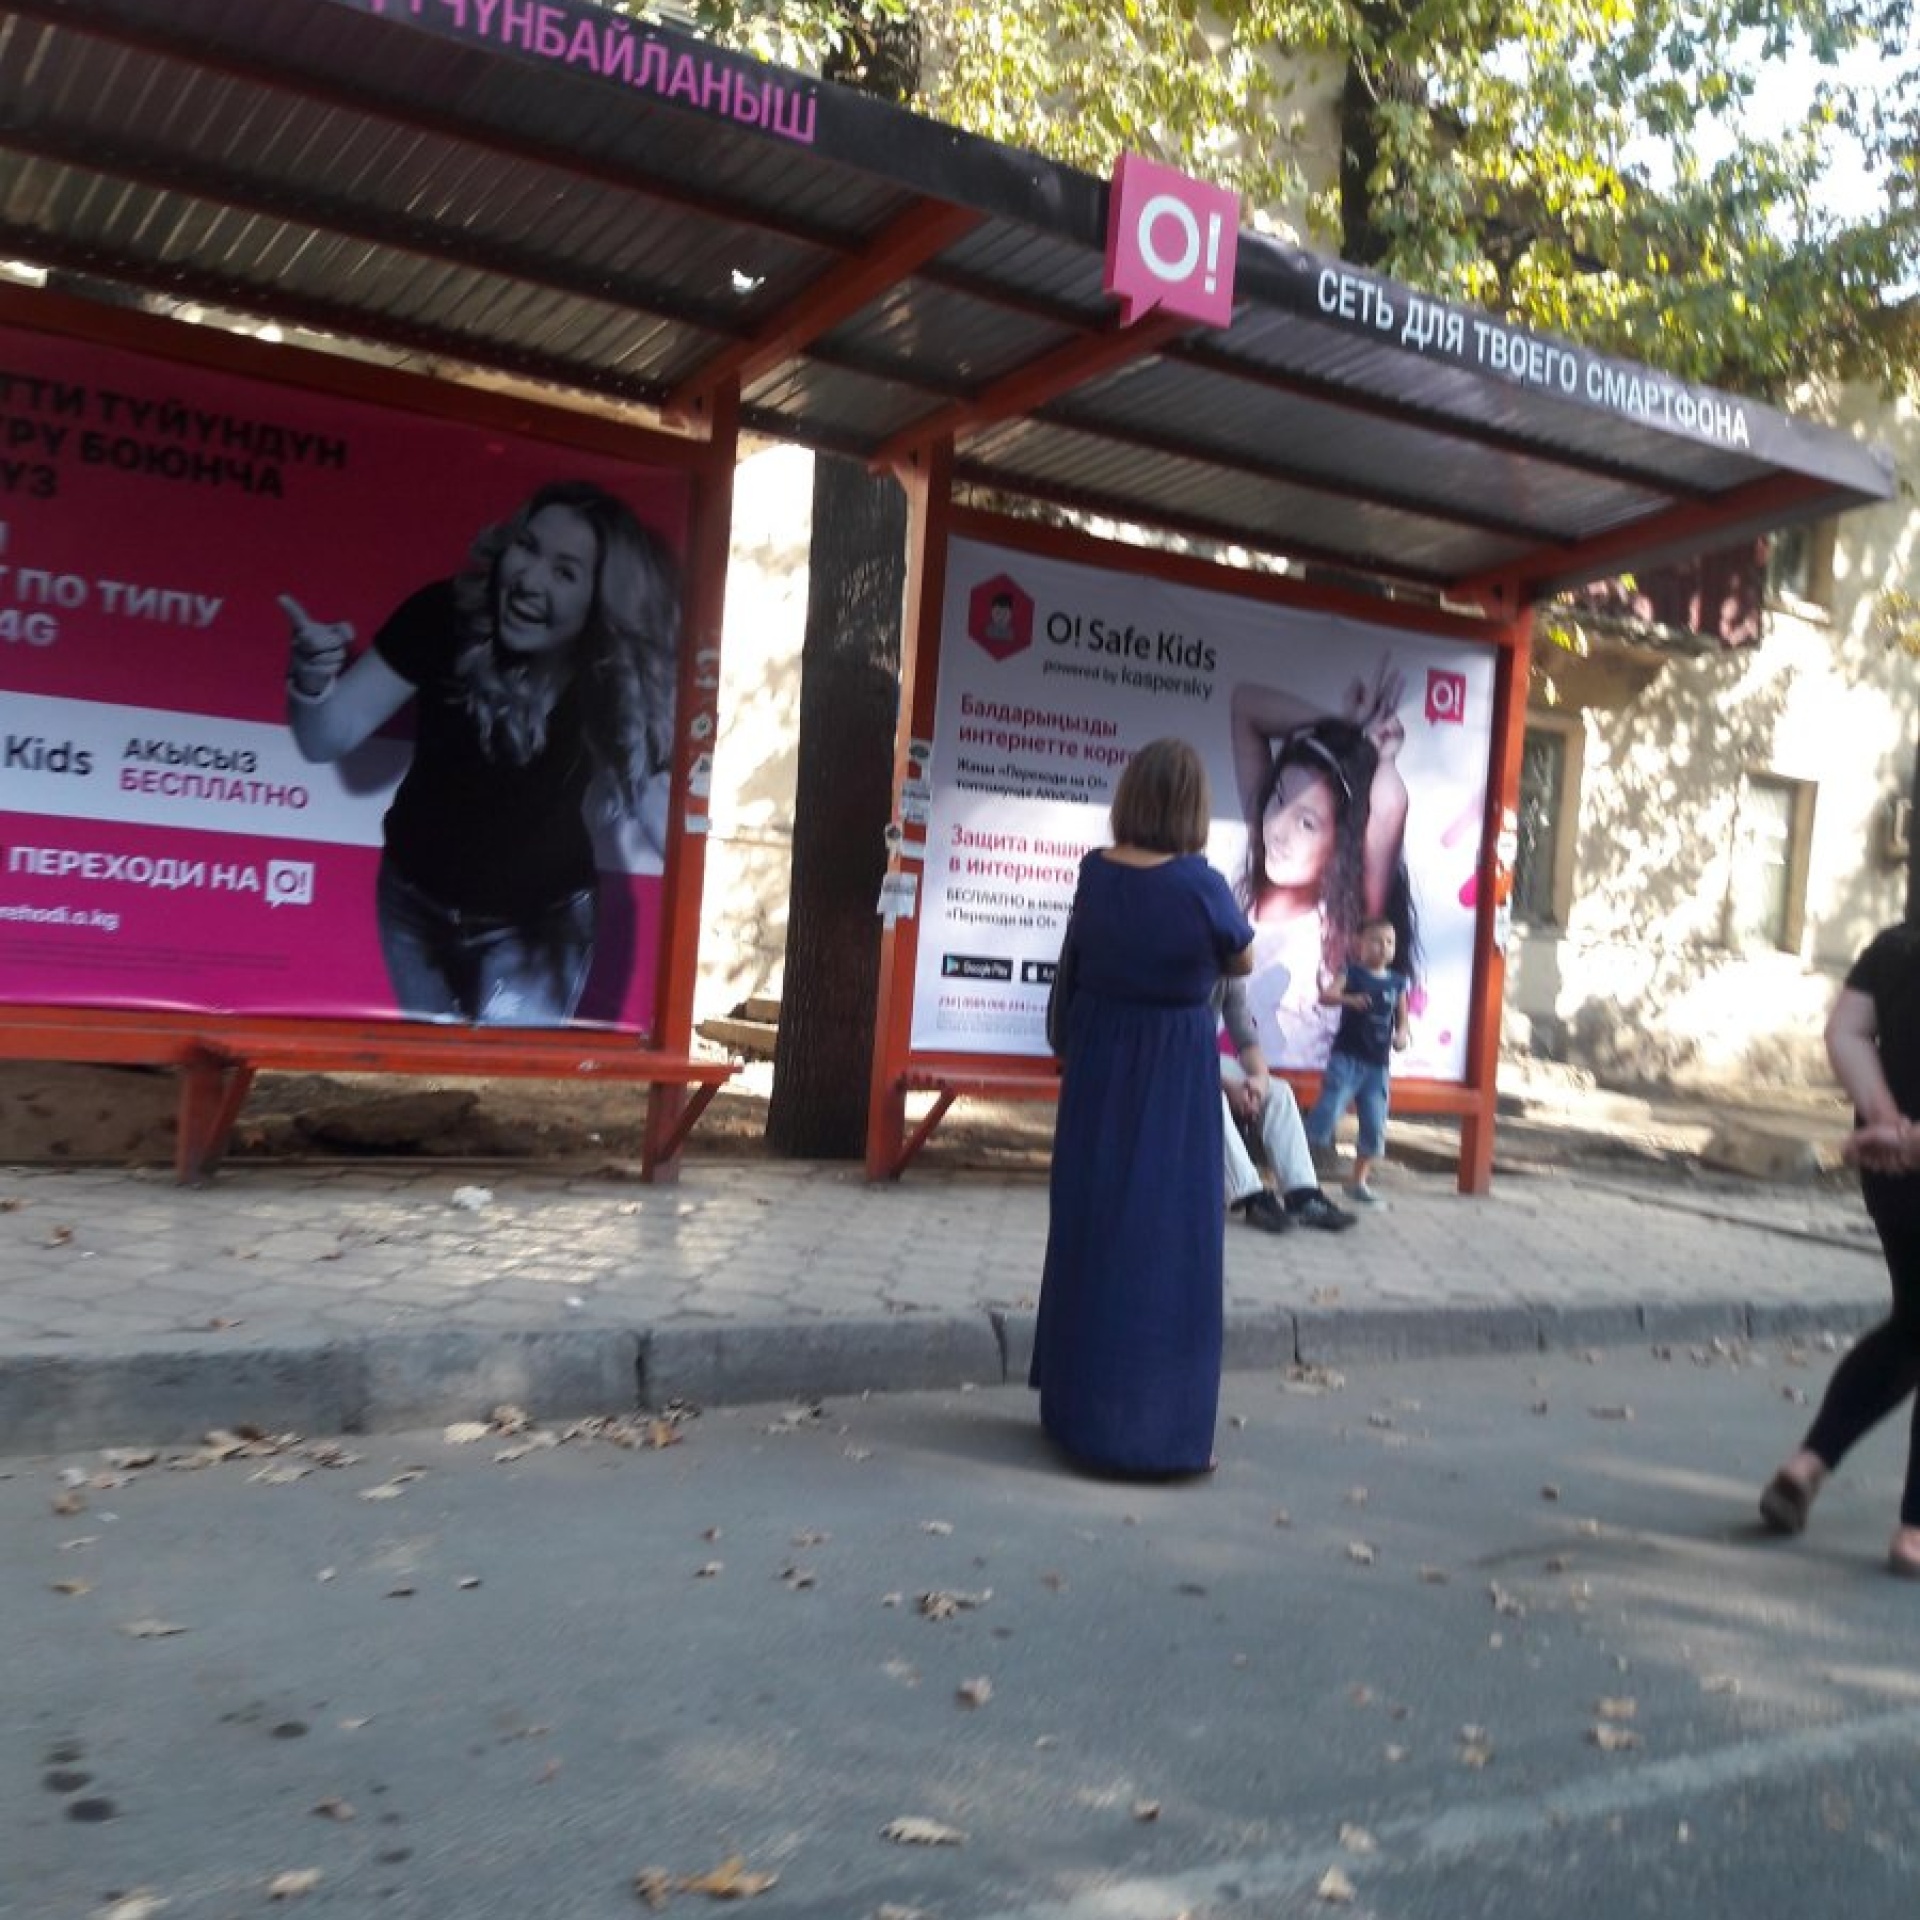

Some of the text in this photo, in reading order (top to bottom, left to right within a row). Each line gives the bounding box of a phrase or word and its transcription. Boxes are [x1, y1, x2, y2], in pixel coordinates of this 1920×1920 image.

[1137, 194, 1222, 294] O!
[1316, 268, 1750, 448] СЕТЬ ДЛЯ ТВОЕГО СМАРТФОНА
[80, 431, 284, 498] БОЮНЧА
[17, 567, 224, 628] ПО ТИПУ
[1047, 612, 1217, 672] O! Safe Kids
[1043, 658, 1213, 701] powered by kaspersky
[1432, 680, 1461, 718] O!
[961, 694, 1118, 738] Балдарыңызды
[3, 734, 94, 777] Kids
[122, 737, 259, 774] АКЫСЫЗ
[959, 725, 1078, 760] интернетте
[119, 768, 309, 810] БЕСПЛАТНО
[951, 823, 1027, 852] Защита
[8, 845, 205, 891] ПЕРЕХОДИ
[210, 863, 261, 892] НА
[949, 856, 1074, 886] в интернете
